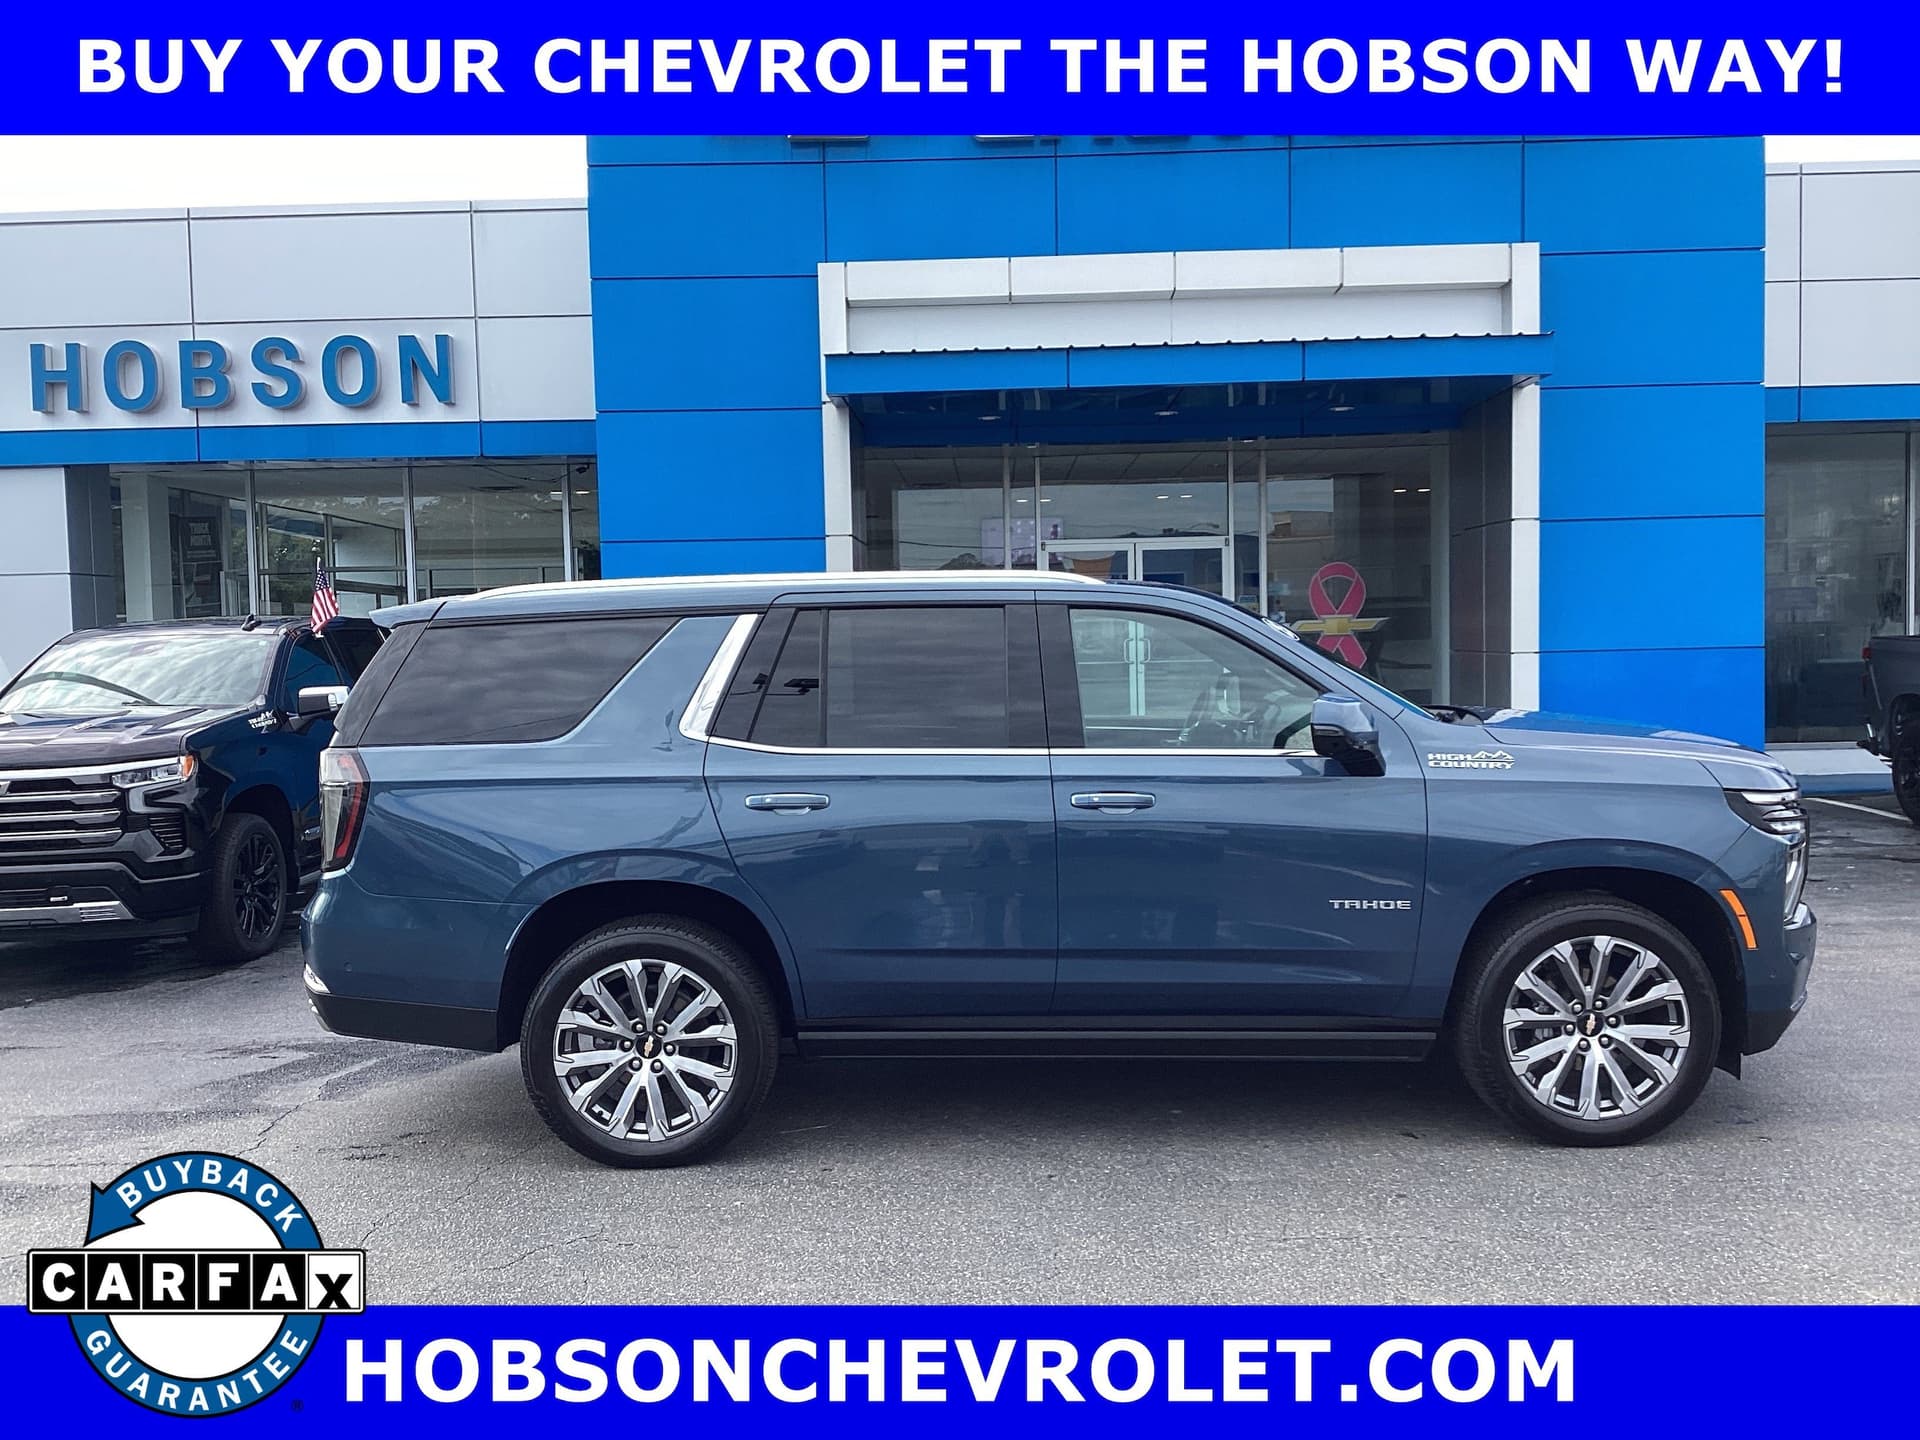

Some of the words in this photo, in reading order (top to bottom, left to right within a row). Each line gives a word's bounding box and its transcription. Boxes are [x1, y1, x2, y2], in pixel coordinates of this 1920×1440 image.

[30, 334, 455, 414] HOBSON
[1428, 760, 1514, 769] COUNTRY
[1328, 899, 1411, 909] TAHOE
